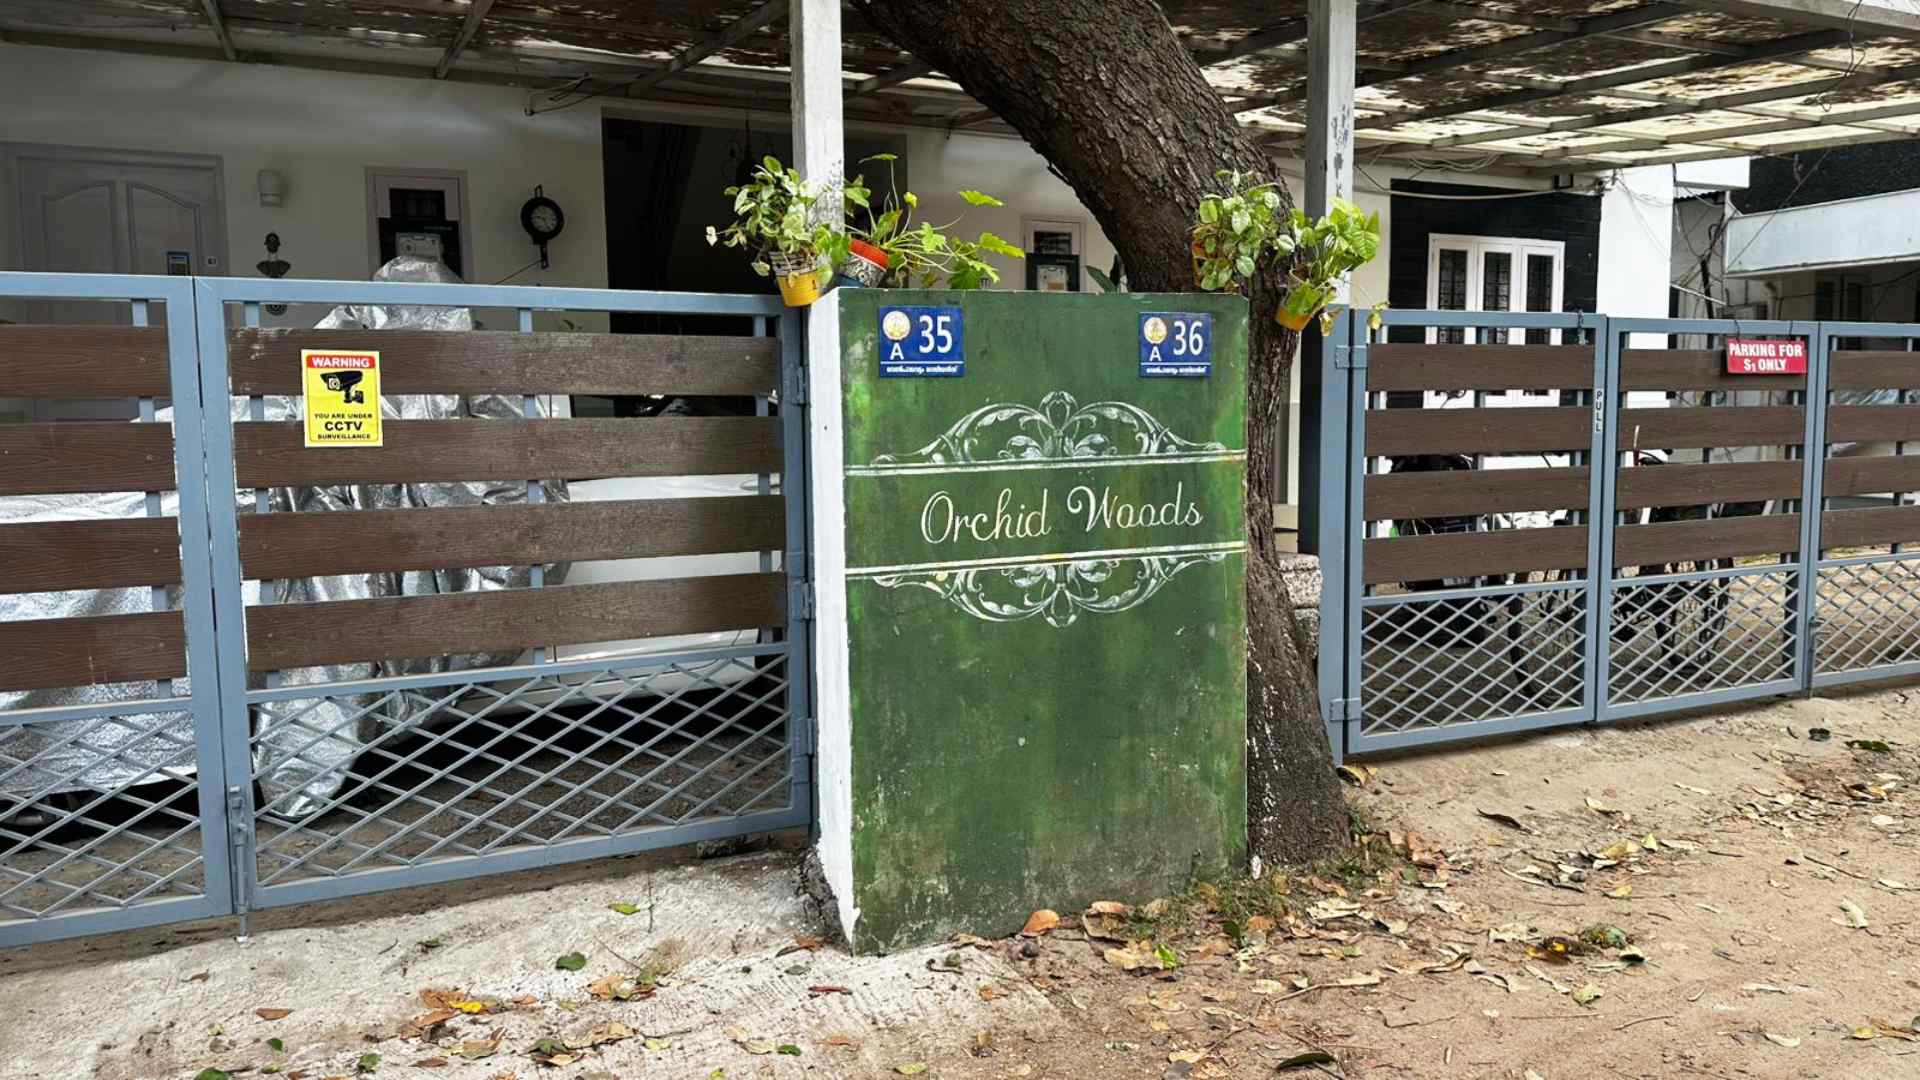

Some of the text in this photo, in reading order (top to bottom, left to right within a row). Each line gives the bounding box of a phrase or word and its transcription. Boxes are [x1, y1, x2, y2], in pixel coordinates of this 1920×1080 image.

[918, 314, 953, 354] 35
[1173, 320, 1204, 356] 36
[889, 342, 905, 361] A
[1148, 345, 1162, 362] A
[1729, 342, 1803, 357] PARKING FOR
[311, 356, 370, 368] WARNING
[1758, 358, 1787, 371] ONLY
[1595, 390, 1603, 432] PULL
[324, 421, 363, 431] CCTV
[921, 481, 1204, 545] Orchid Woods
